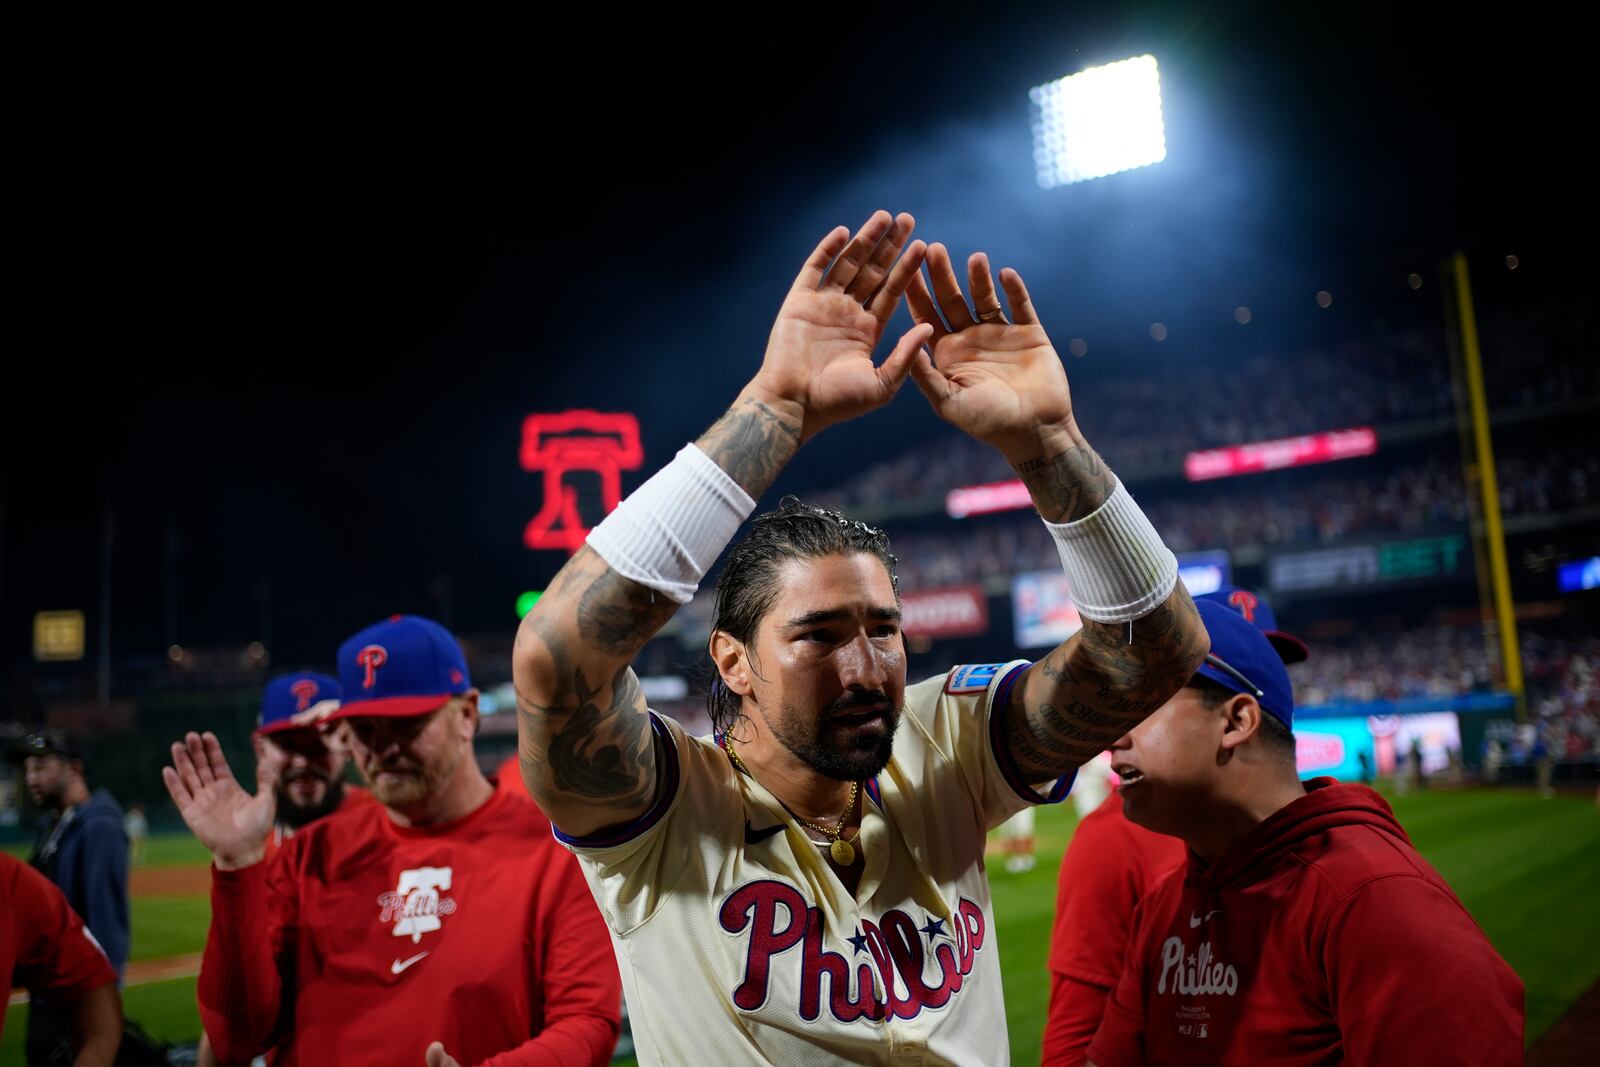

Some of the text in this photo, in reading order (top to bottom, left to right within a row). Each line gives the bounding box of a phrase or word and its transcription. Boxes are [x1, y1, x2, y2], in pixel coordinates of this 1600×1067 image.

[356, 644, 388, 690] P
[377, 890, 458, 923] Phillies
[719, 879, 985, 1022] Phillies
[1157, 935, 1239, 997] Phillies
